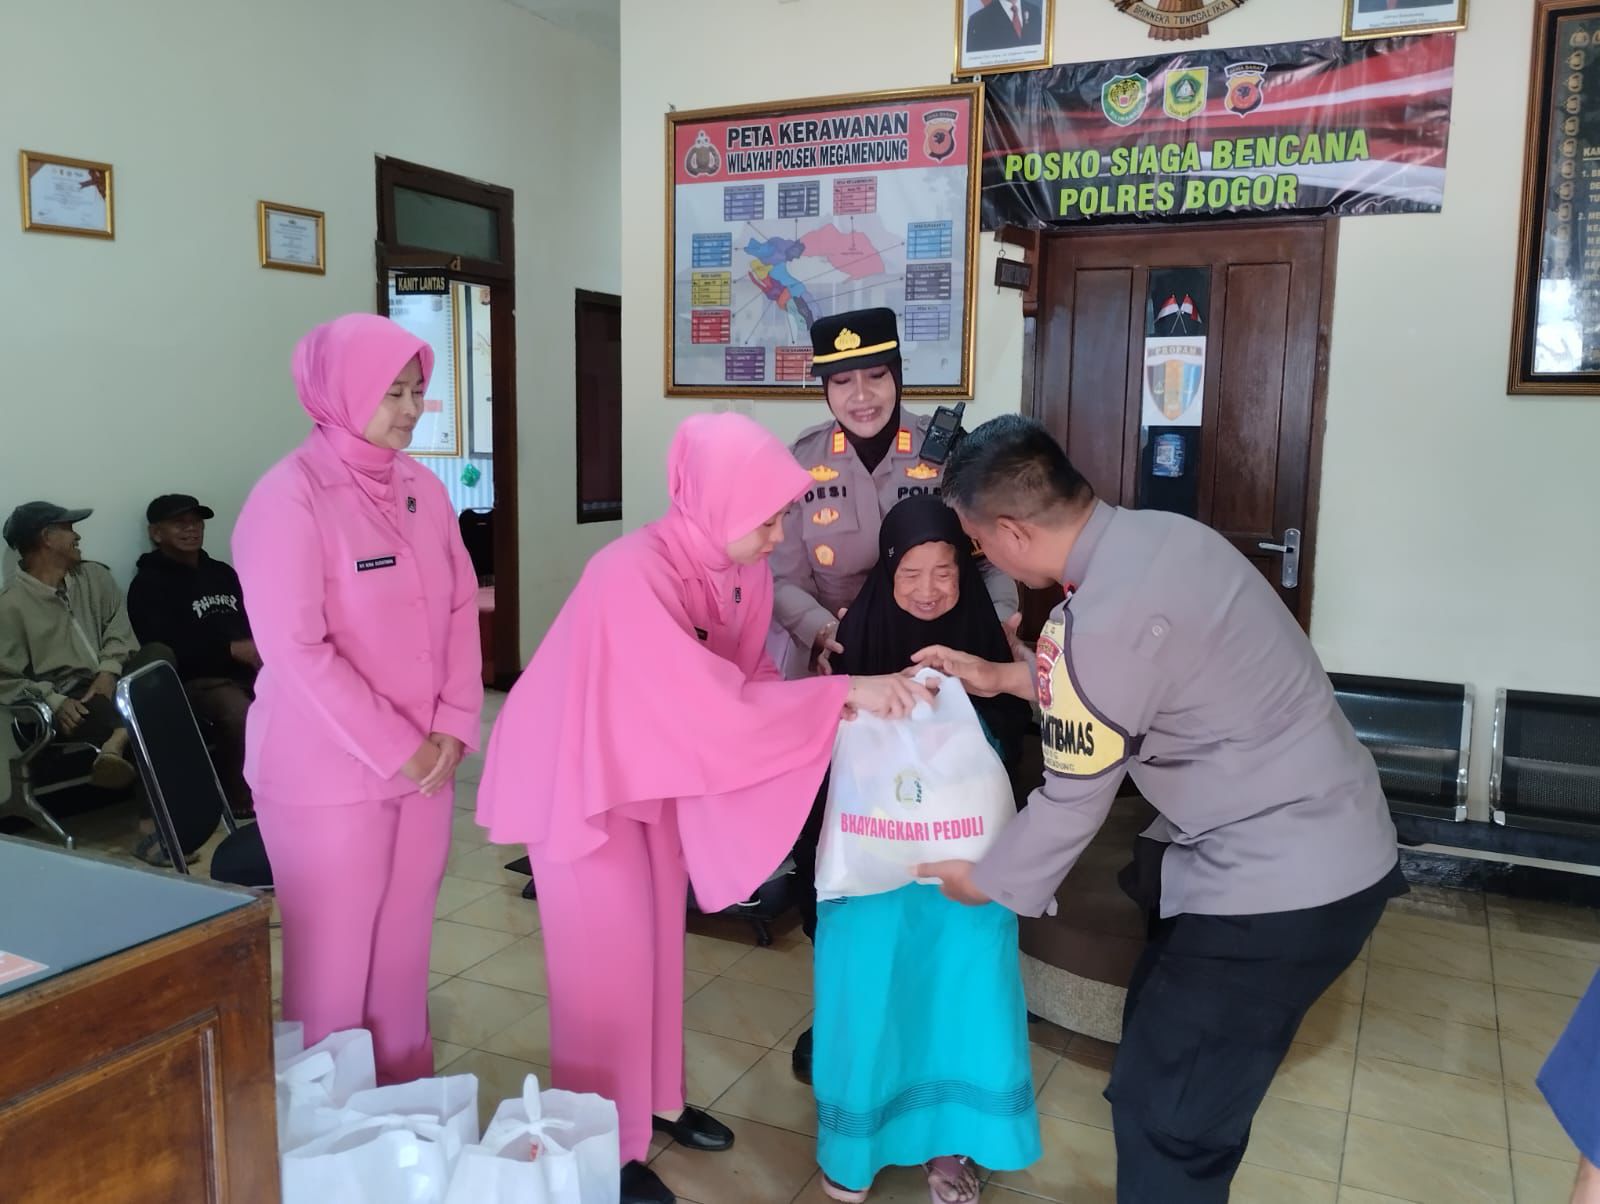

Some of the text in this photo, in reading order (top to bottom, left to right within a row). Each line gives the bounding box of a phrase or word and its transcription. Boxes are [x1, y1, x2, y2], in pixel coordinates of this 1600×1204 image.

[1133, 4, 1170, 25] BHINNEKA
[727, 112, 909, 148] PETA KERAWANAN
[727, 139, 908, 174] WILAYAH POLSEK MEGAMENDUNG
[1004, 129, 1370, 182] POSKO SIAGA BENCANA
[1059, 174, 1299, 216] POLRES BOGOR
[398, 276, 445, 291] KANIT LANTAS
[1155, 346, 1197, 355] PROPAM
[804, 485, 847, 503] DESI
[933, 815, 984, 841] PEDULI
